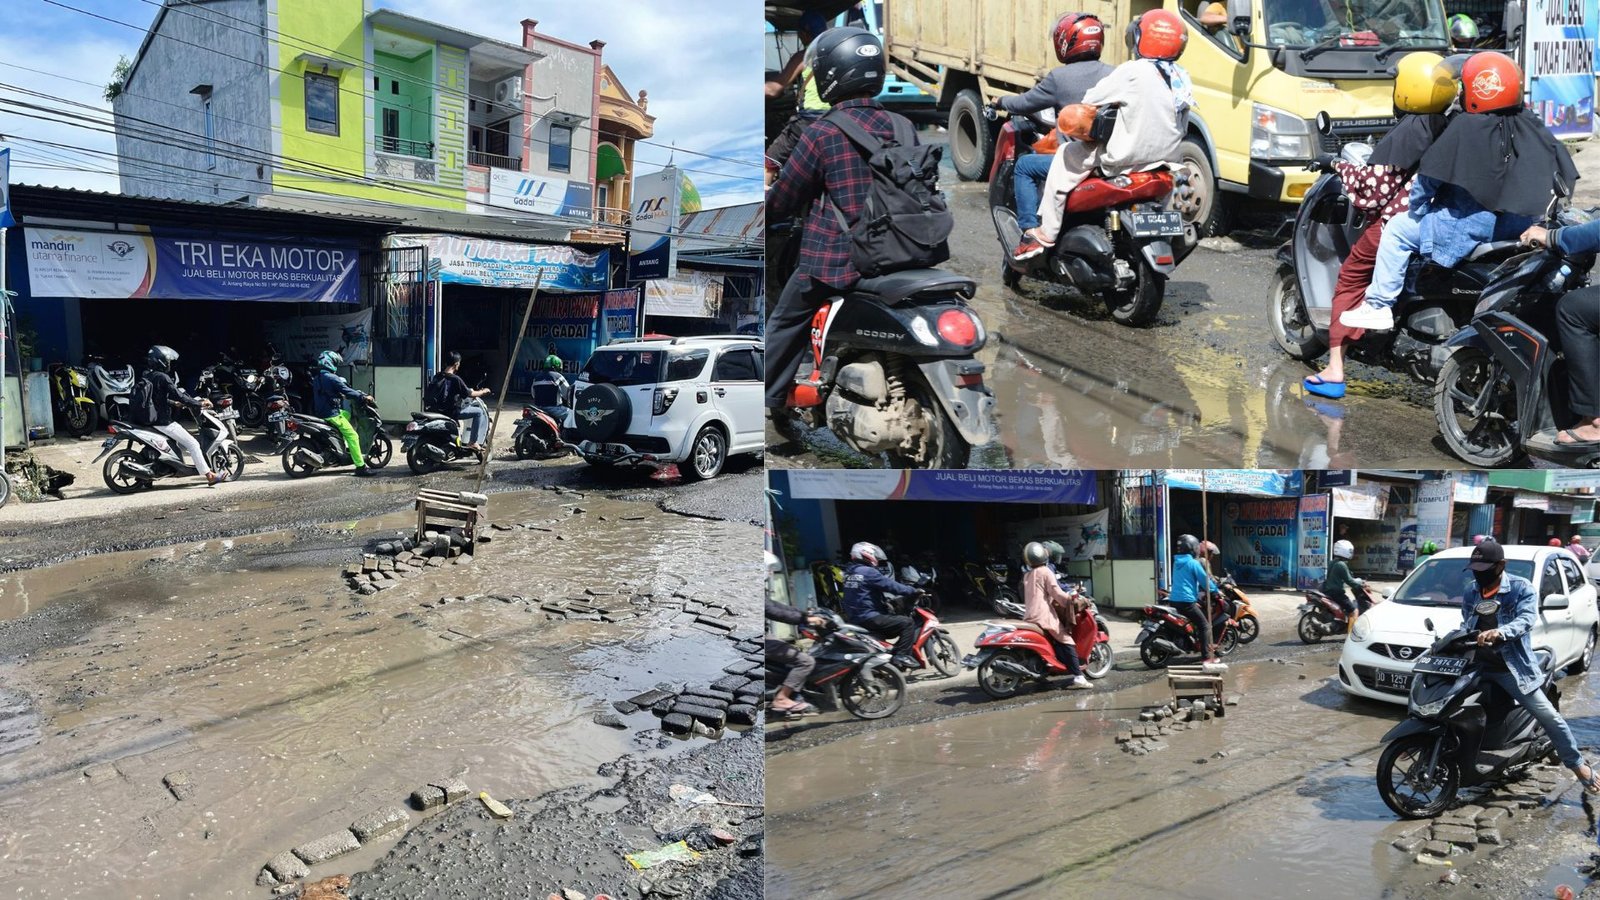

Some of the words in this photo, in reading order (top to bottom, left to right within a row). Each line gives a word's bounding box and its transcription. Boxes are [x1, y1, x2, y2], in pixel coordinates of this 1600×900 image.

[1546, 0, 1565, 26] JUAL
[1568, 0, 1584, 25] BELI
[1534, 41, 1560, 75] TUKAR
[1562, 40, 1594, 74] TAMBAH
[1331, 119, 1387, 127] ITSUBISHI
[514, 196, 535, 207] Gadai
[568, 209, 589, 218] ANTANG
[31, 240, 75, 252] mandiri
[32, 251, 62, 262] utama
[64, 250, 98, 264] finance
[175, 241, 213, 267] TRI
[221, 244, 266, 268] EKA
[270, 247, 346, 272] MOTOR
[638, 258, 660, 267] ANTANG
[182, 269, 205, 278] JUAL
[206, 270, 226, 279] BELI
[227, 271, 260, 280] MOTOR
[261, 272, 289, 281] BEKAS
[290, 273, 342, 283] BERKUALITAS
[462, 269, 478, 277] JUAL
[551, 324, 589, 338] GADAI
[856, 329, 905, 340] SCOOPY
[935, 473, 956, 481] JUAL
[958, 473, 977, 482] BELI
[978, 475, 1007, 483] MOTOR
[1008, 476, 1034, 484] BEKAS
[1035, 477, 1081, 486] BERKUALITAS
[1232, 525, 1254, 536] TITIP
[1257, 525, 1288, 537] GADAI
[1254, 540, 1262, 552] &
[1235, 554, 1257, 566] JUAL
[1260, 555, 1282, 567] BELI
[1391, 673, 1408, 685] 1257
